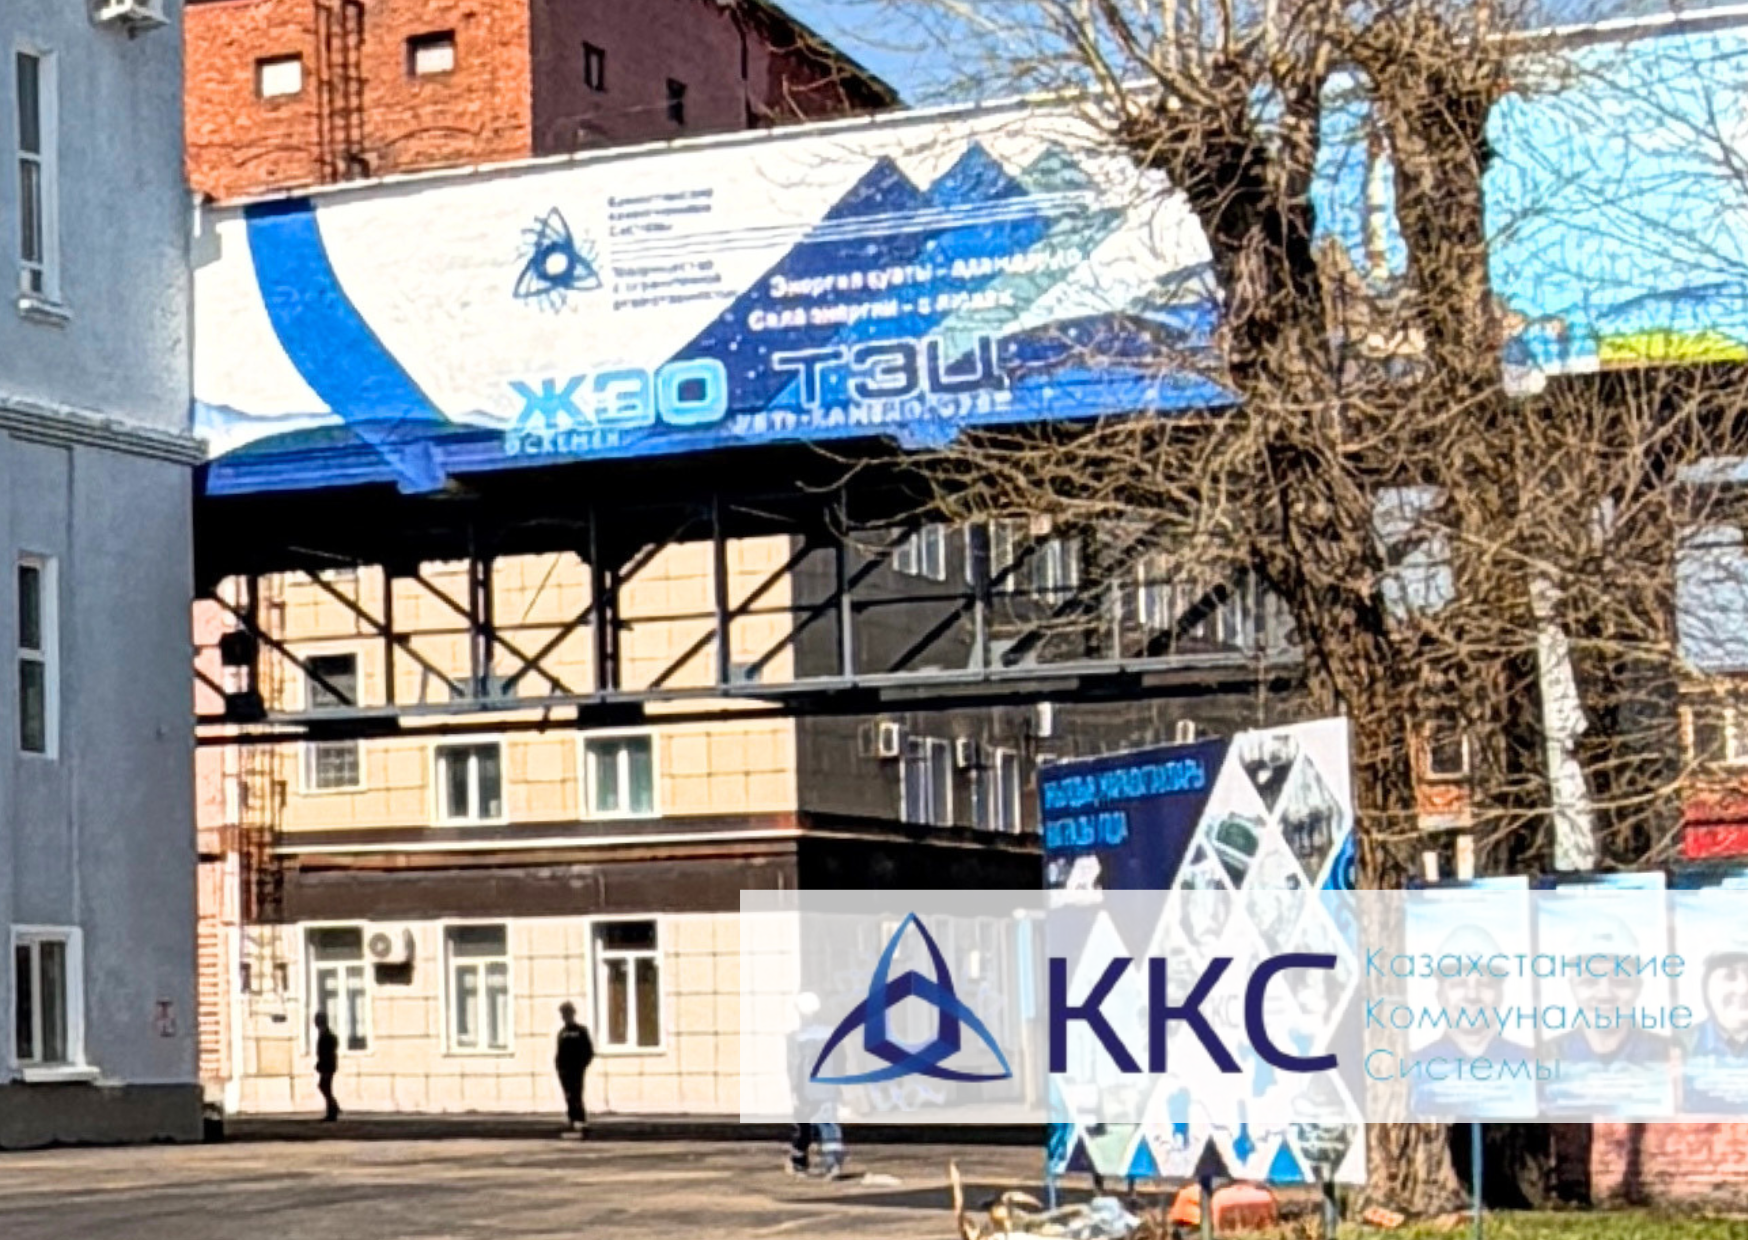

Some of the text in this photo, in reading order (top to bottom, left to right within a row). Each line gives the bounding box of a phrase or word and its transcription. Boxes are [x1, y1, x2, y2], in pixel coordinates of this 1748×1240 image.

[747, 307, 807, 331] Сила
[506, 331, 1011, 429] ЖЭО ТЭЦ
